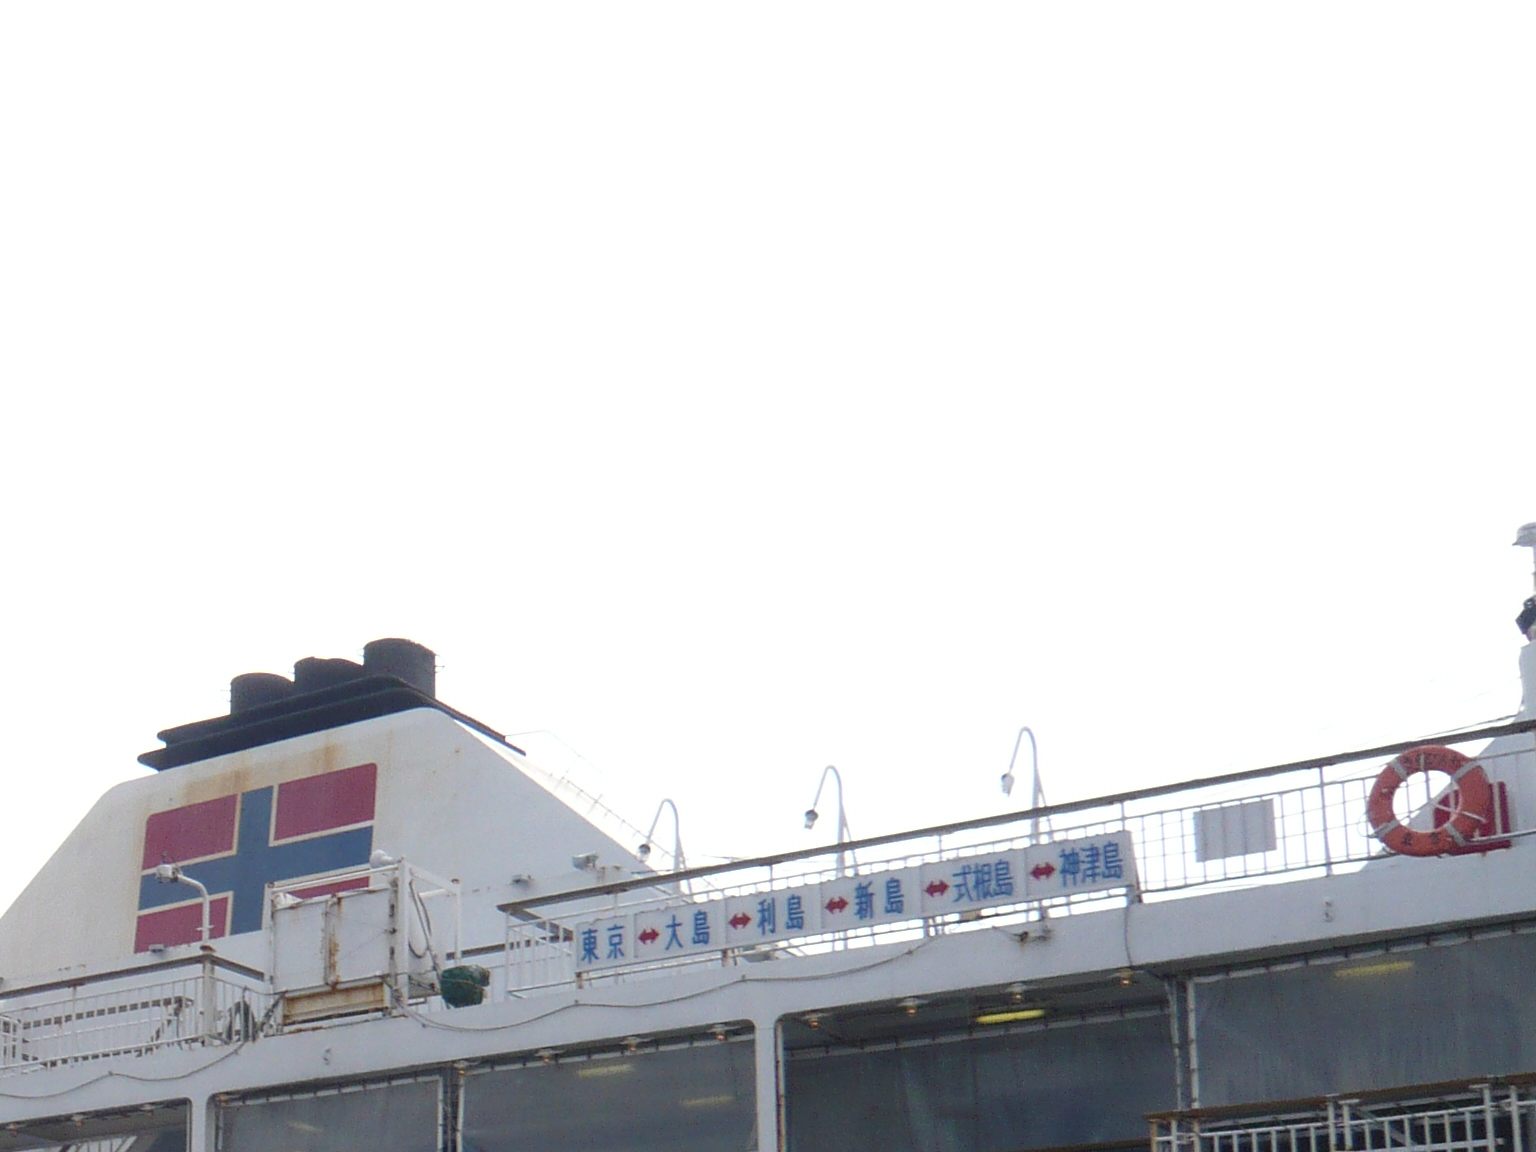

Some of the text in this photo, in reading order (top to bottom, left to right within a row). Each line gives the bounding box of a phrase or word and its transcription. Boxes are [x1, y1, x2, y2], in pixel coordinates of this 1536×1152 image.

[580, 840, 1123, 964] 東京 大島 利島 新島 式根島 神津島
